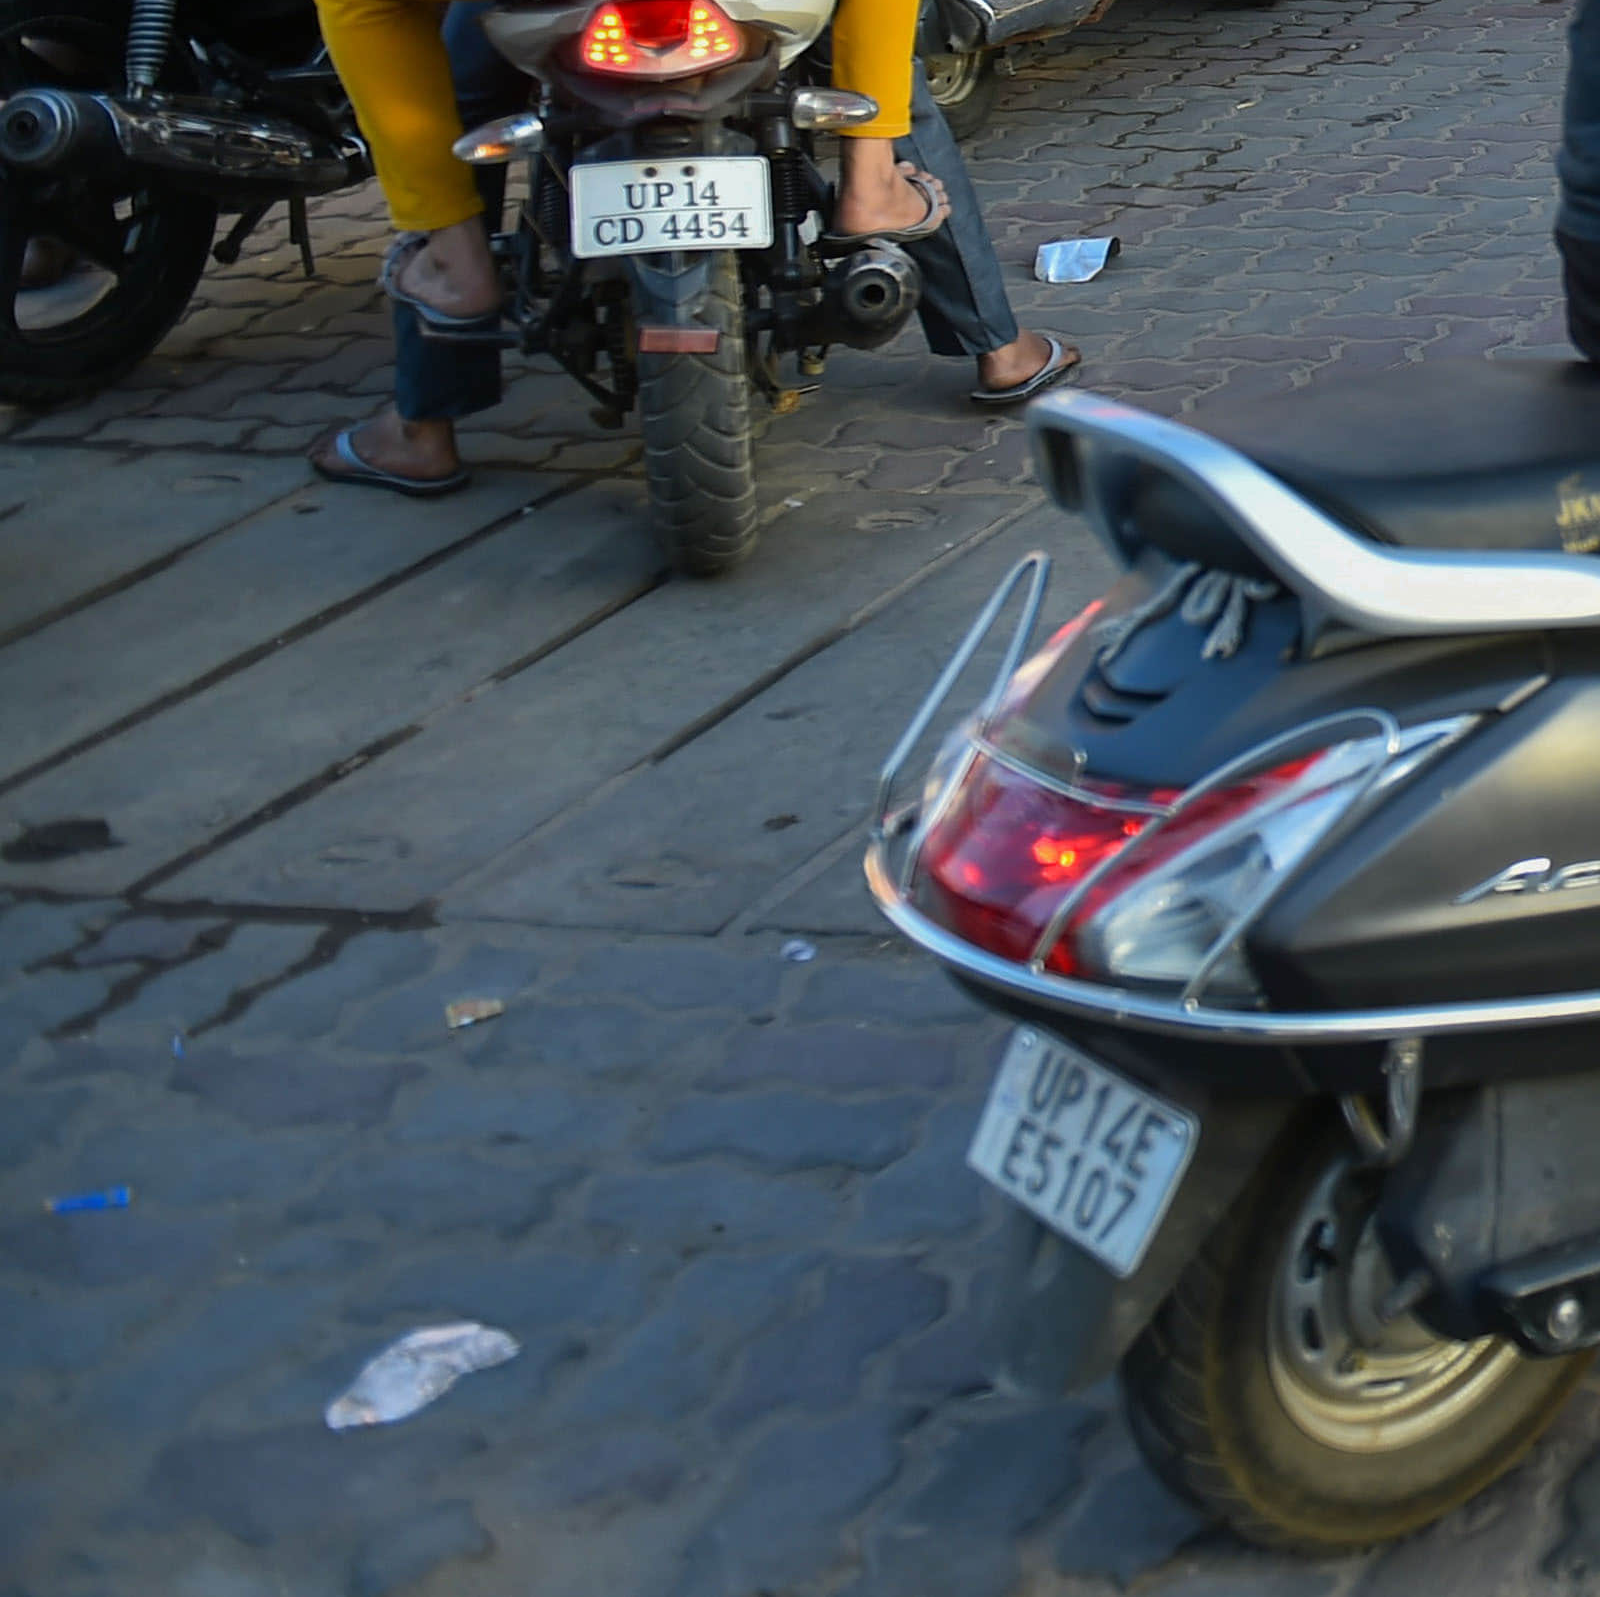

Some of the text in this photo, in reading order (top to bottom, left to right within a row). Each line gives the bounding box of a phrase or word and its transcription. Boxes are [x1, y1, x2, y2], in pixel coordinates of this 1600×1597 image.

[594, 212, 749, 246] CD 4454
[624, 180, 719, 209] UP 14
[1028, 1050, 1168, 1181] UP14E
[1000, 1117, 1138, 1244] E5107
